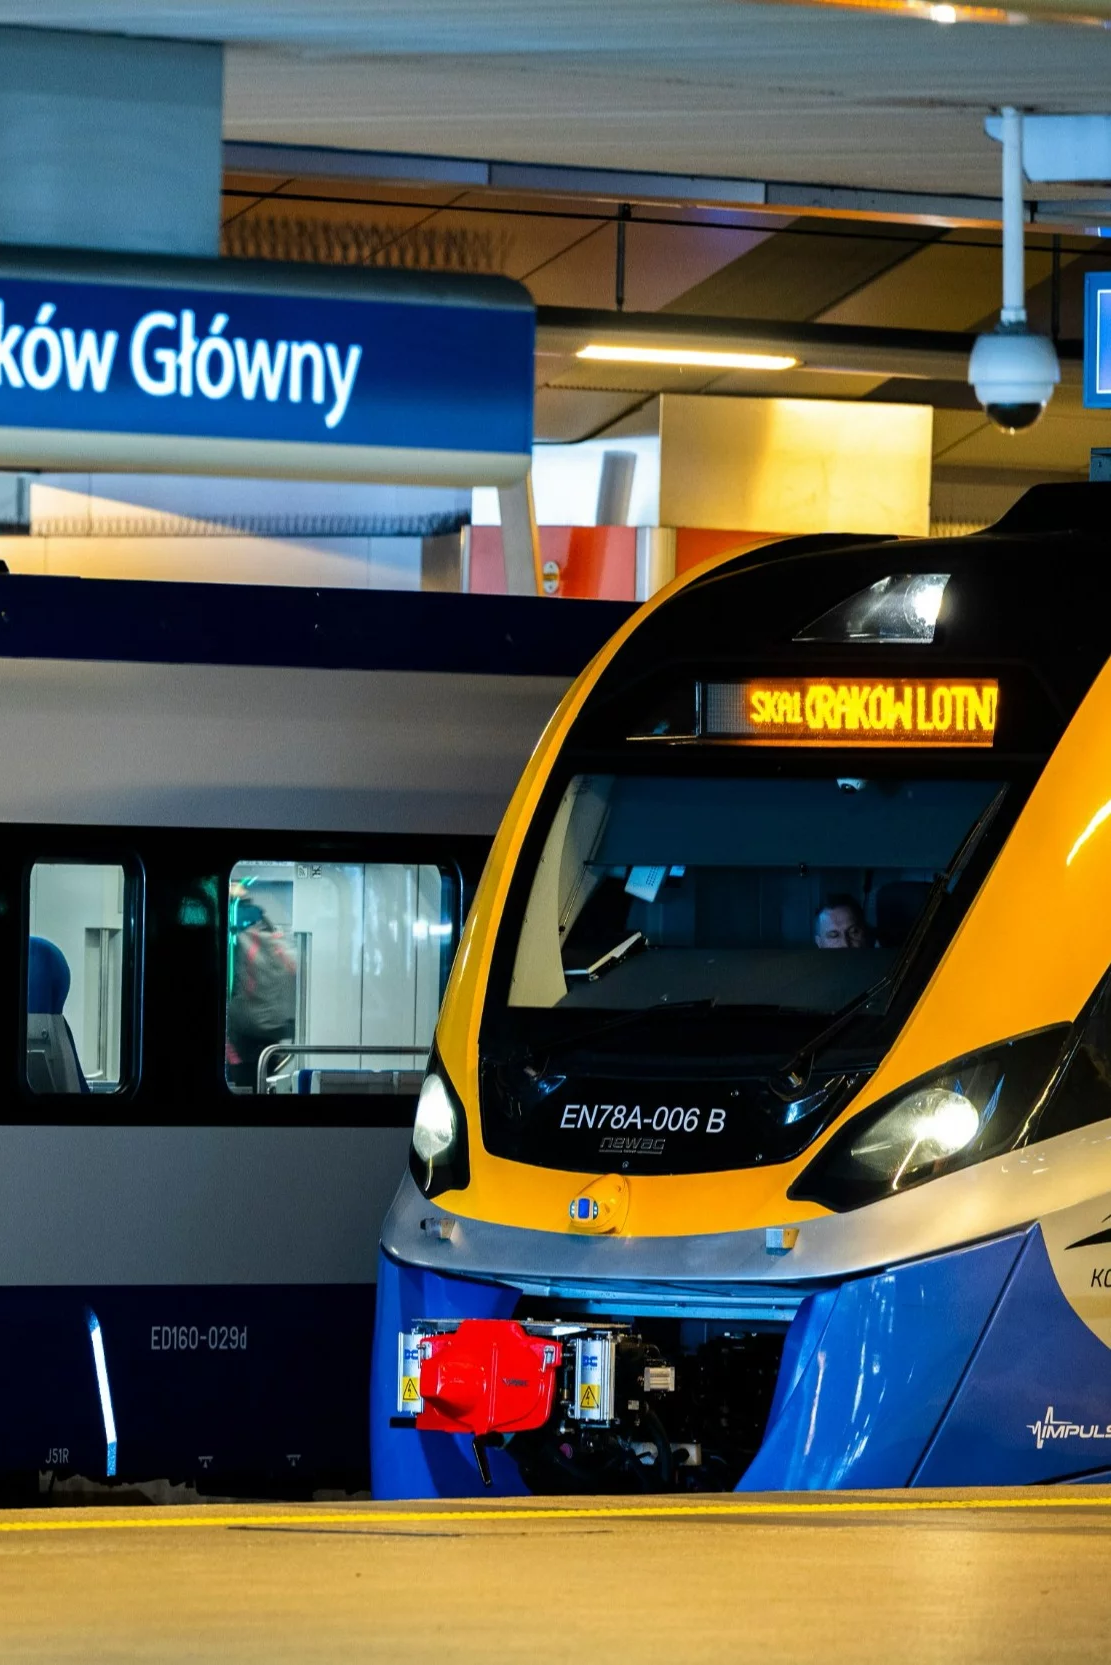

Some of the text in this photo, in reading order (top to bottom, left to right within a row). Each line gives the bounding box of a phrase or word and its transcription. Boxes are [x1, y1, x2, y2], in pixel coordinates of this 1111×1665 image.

[130, 309, 363, 429] Główny
[560, 1104, 726, 1133] EN78A-006 B
[150, 1325, 248, 1351] ED160-029d
[45, 1447, 70, 1464] J51R
